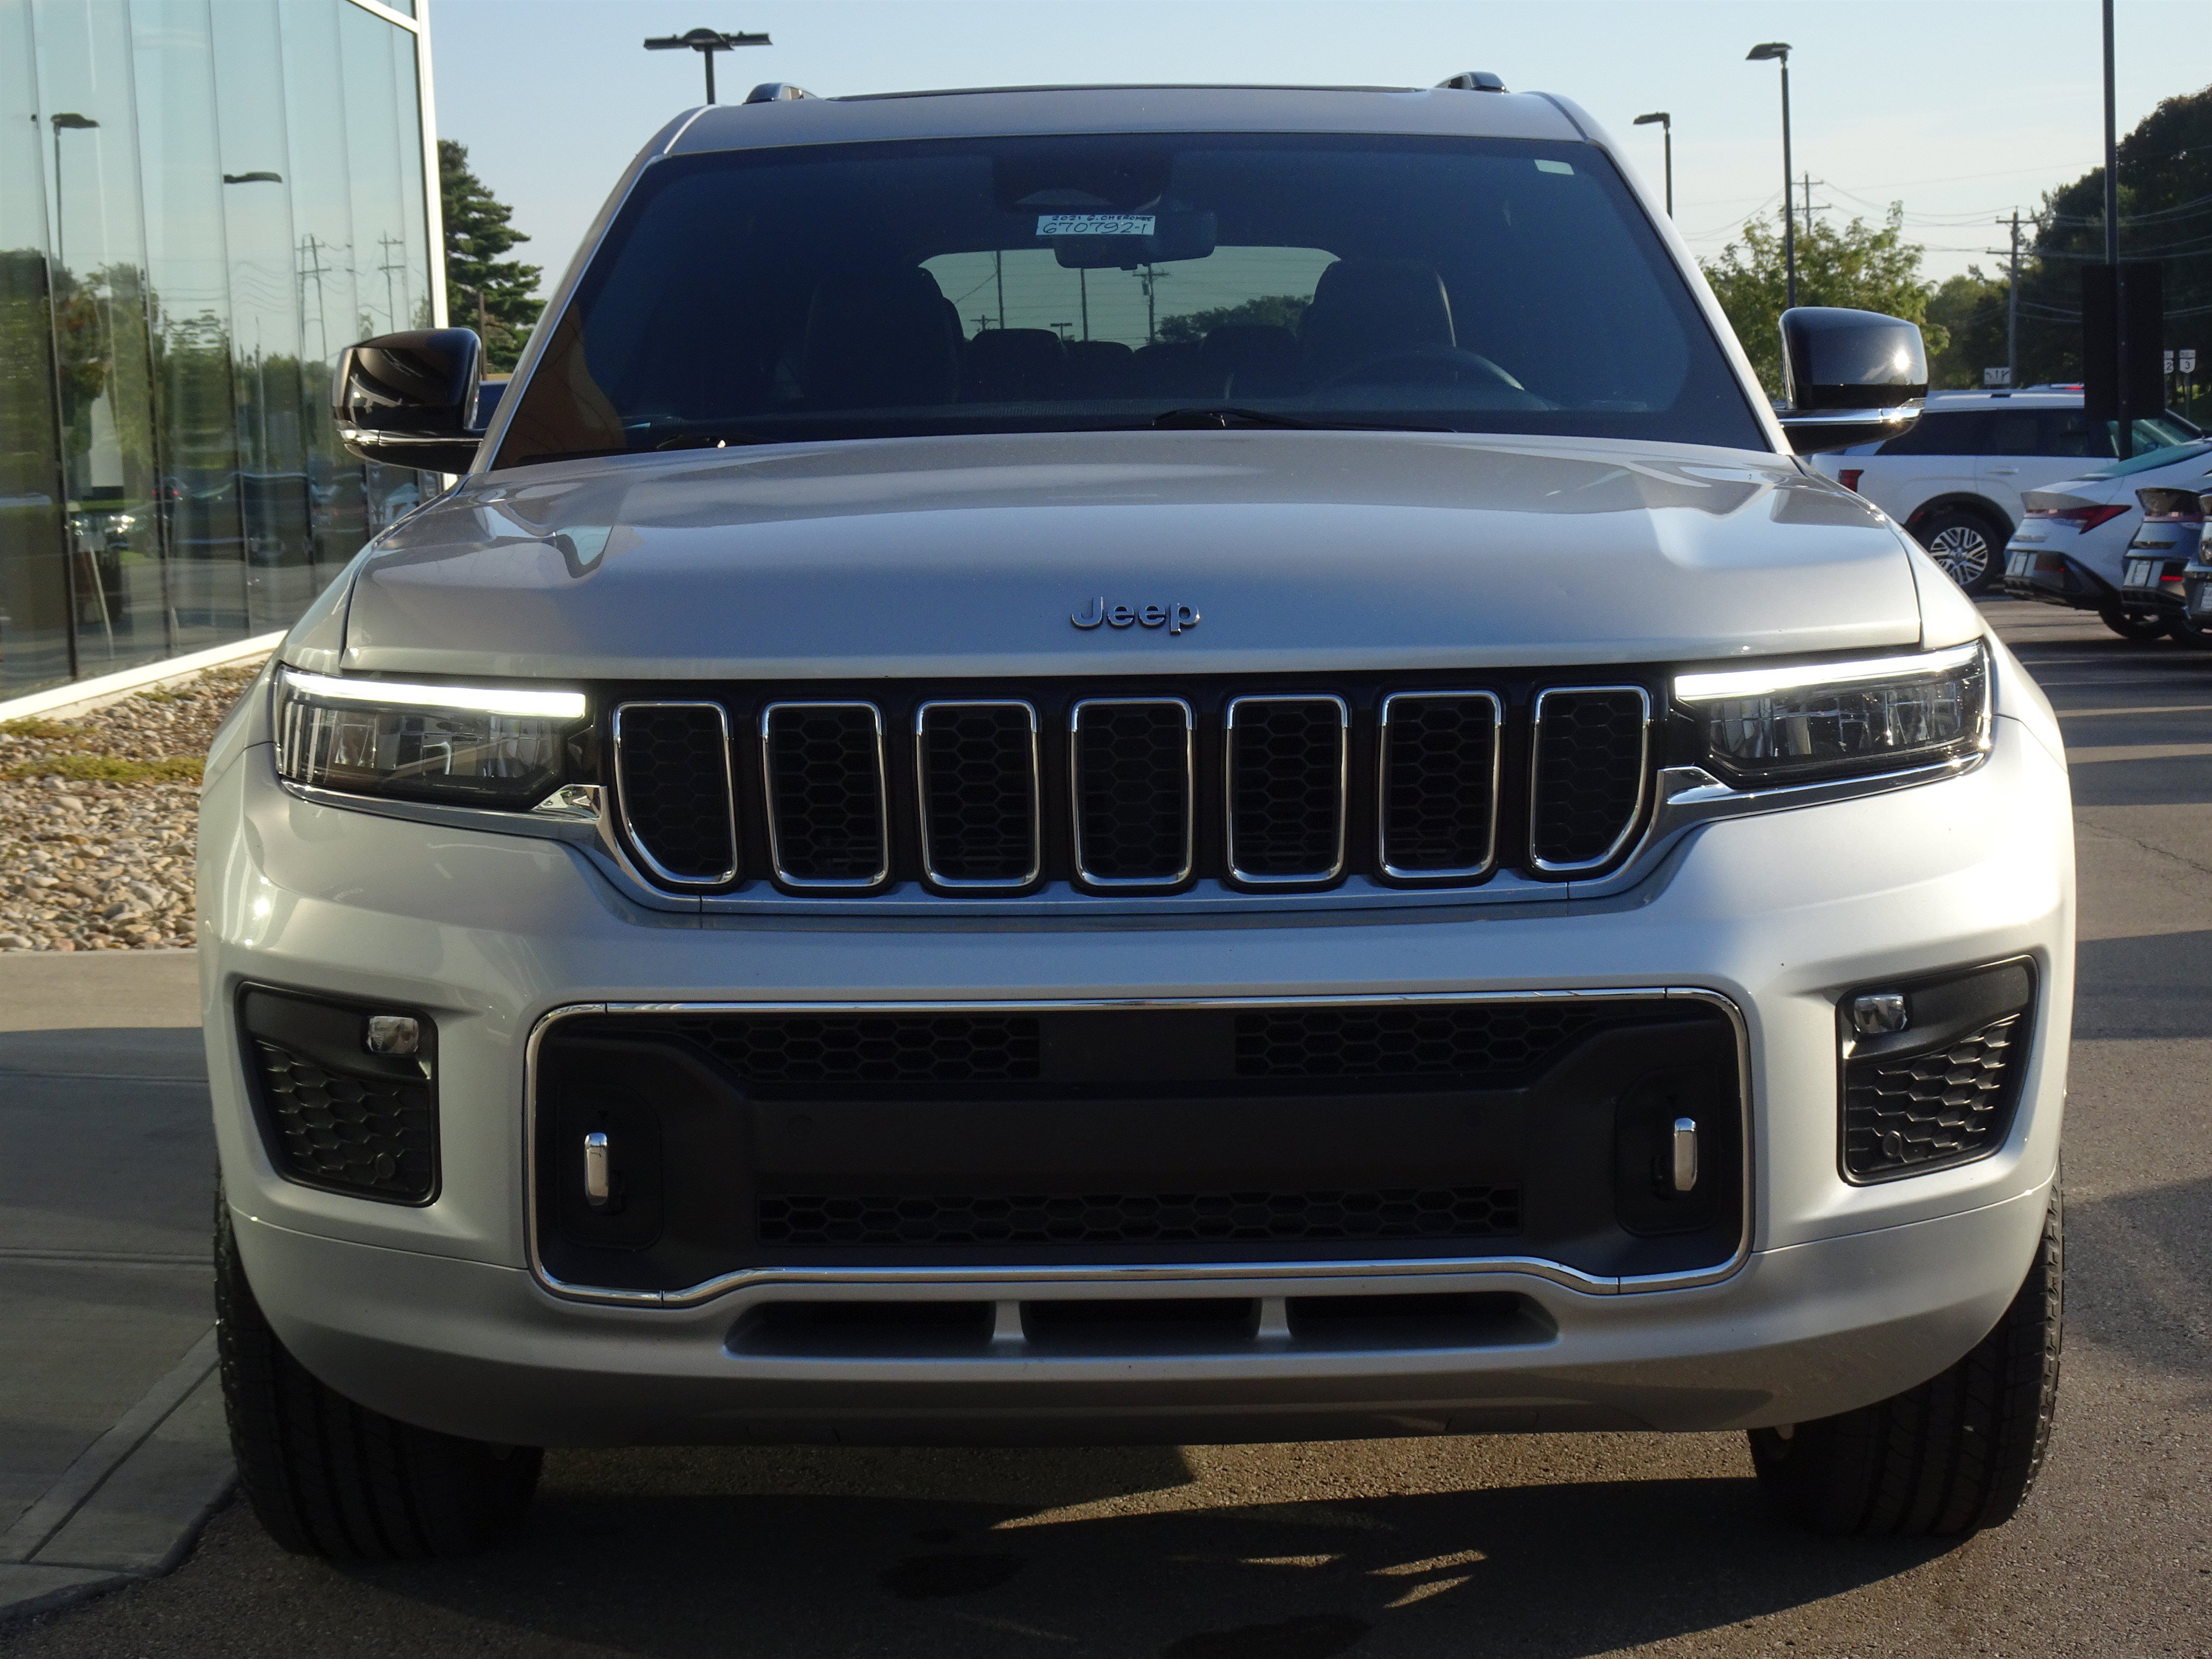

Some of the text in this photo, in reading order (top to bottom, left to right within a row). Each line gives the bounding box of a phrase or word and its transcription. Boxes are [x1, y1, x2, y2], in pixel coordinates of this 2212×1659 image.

[1043, 222, 1148, 234] 670792-1
[2185, 361, 2190, 369] 3
[1071, 596, 1200, 635] Jeep
